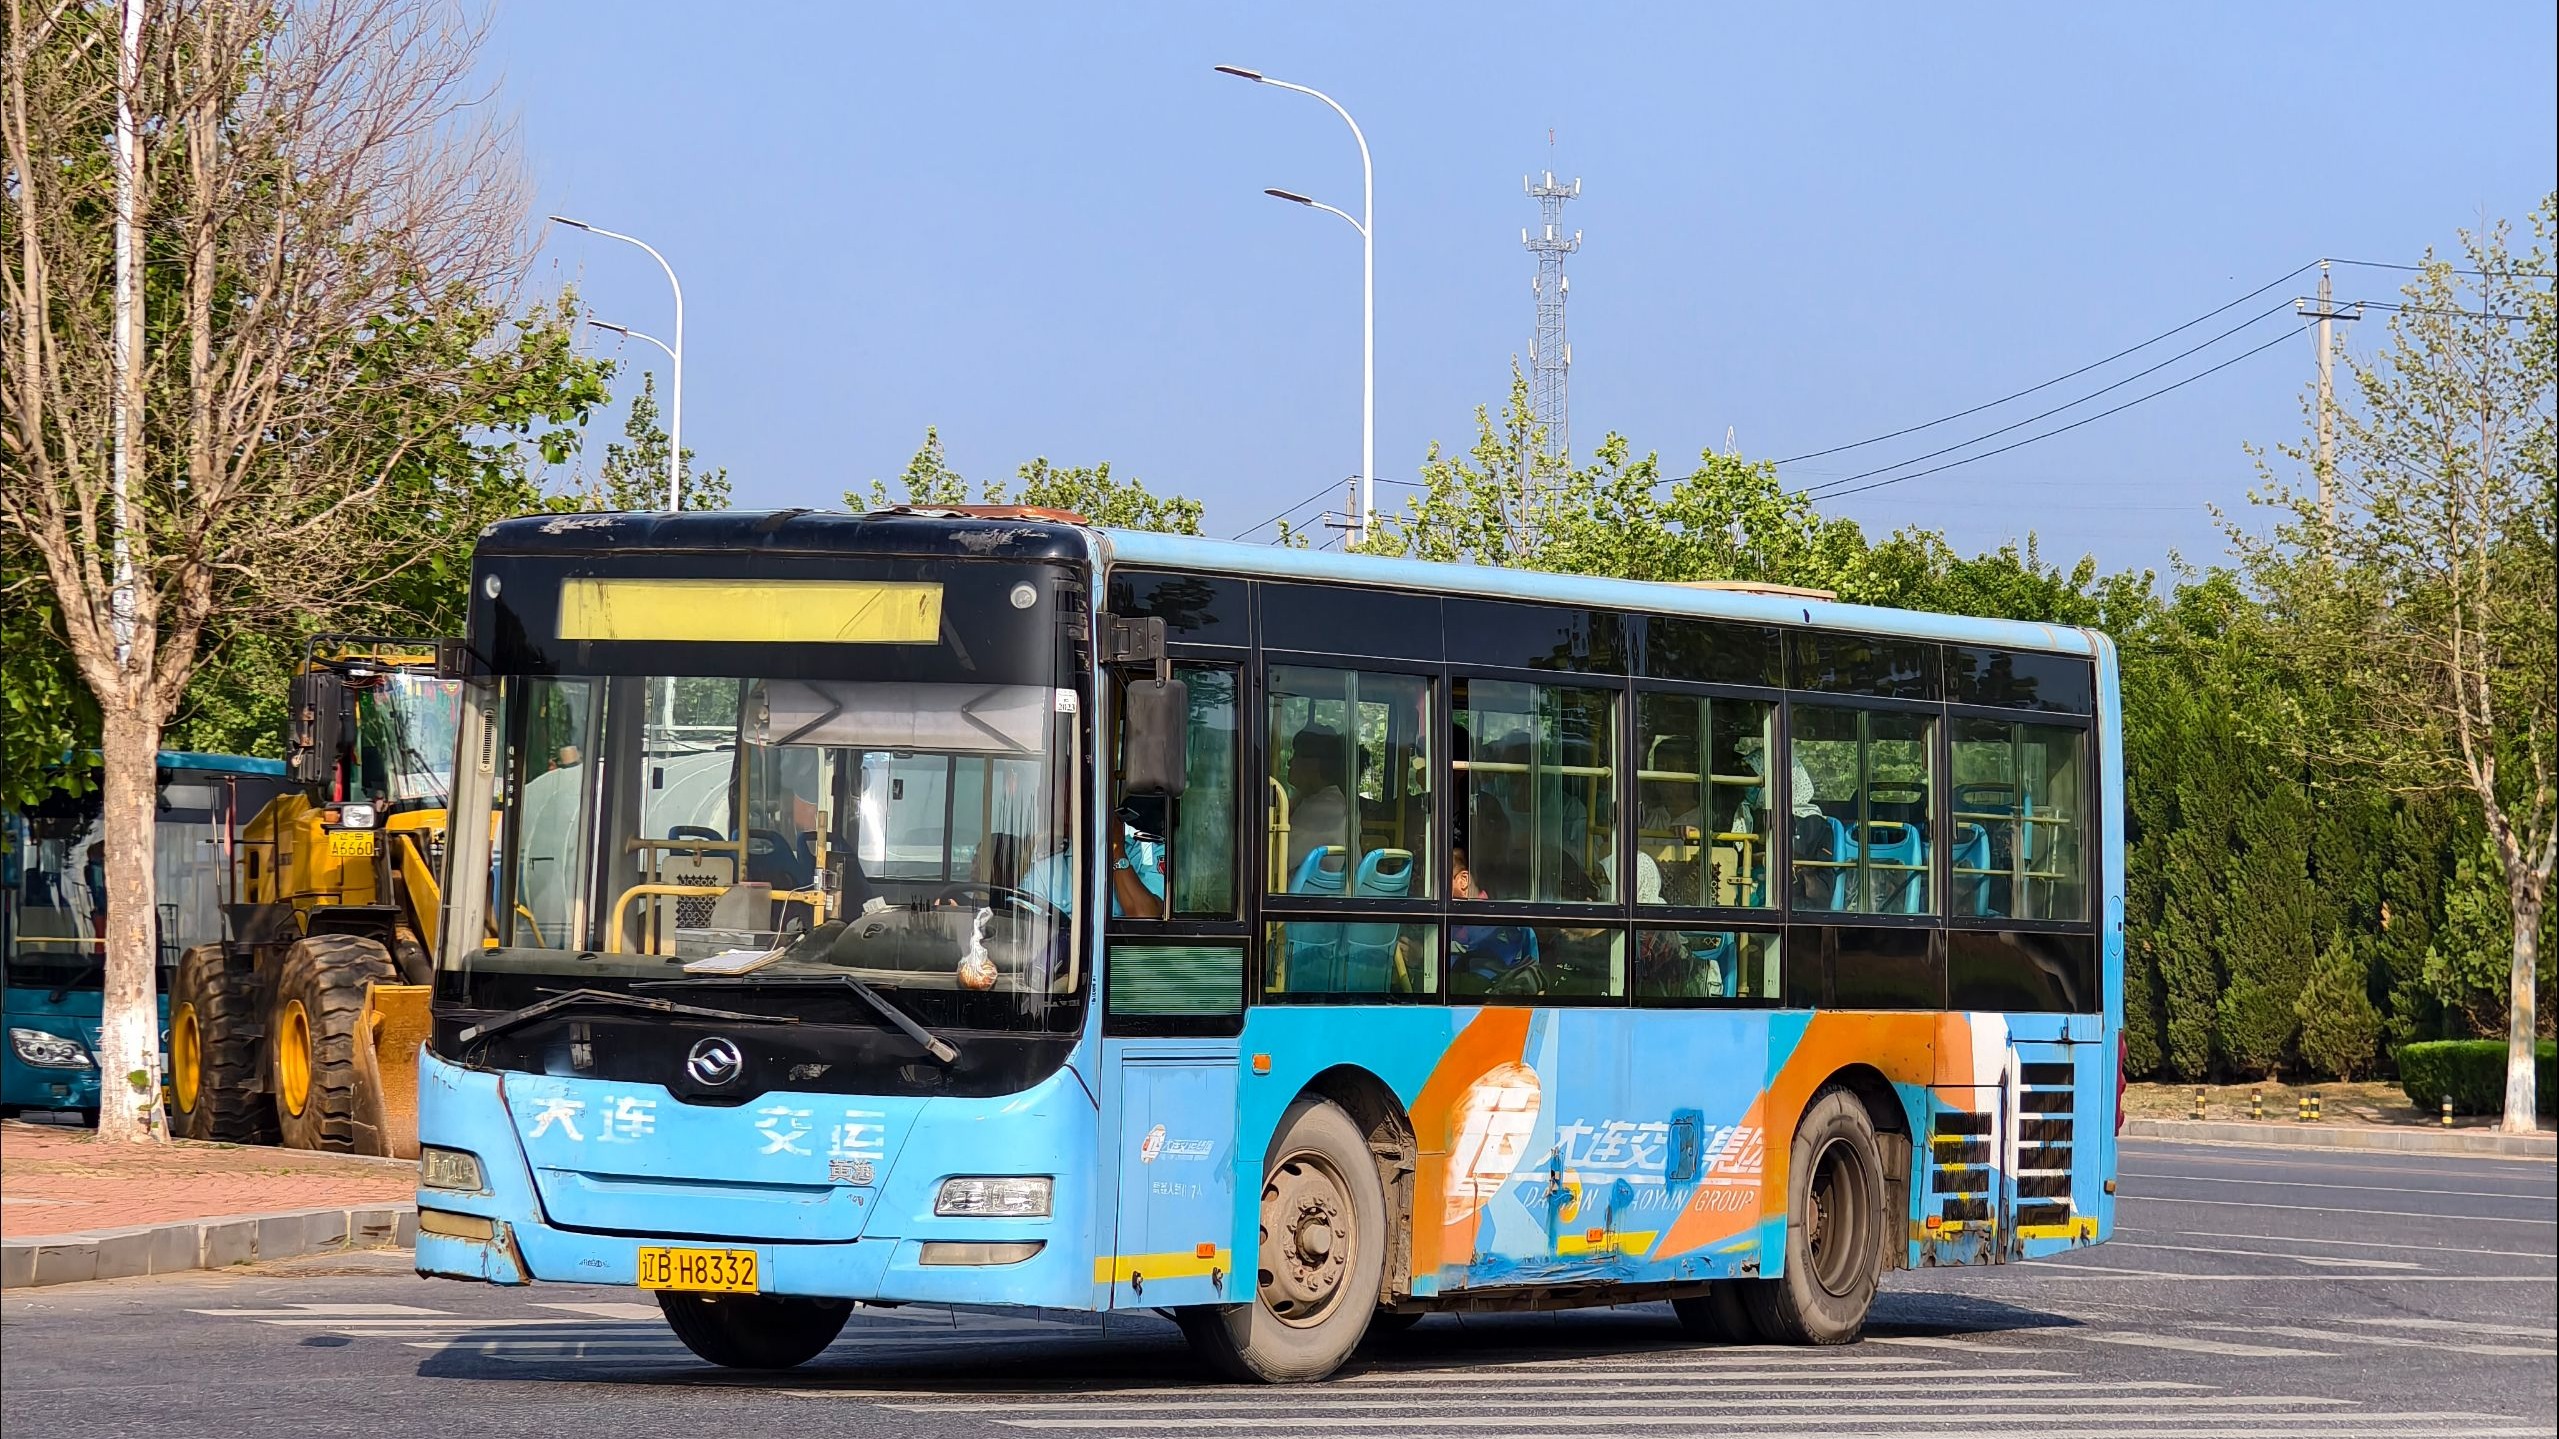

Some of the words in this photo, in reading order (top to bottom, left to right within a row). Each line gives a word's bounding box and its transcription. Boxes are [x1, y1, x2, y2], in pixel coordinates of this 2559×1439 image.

[528, 1095, 657, 1144] 大连
[753, 1105, 886, 1160] 交运
[1535, 1118, 1763, 1174] 大连交集团
[1695, 1190, 1755, 1212] GROUP
